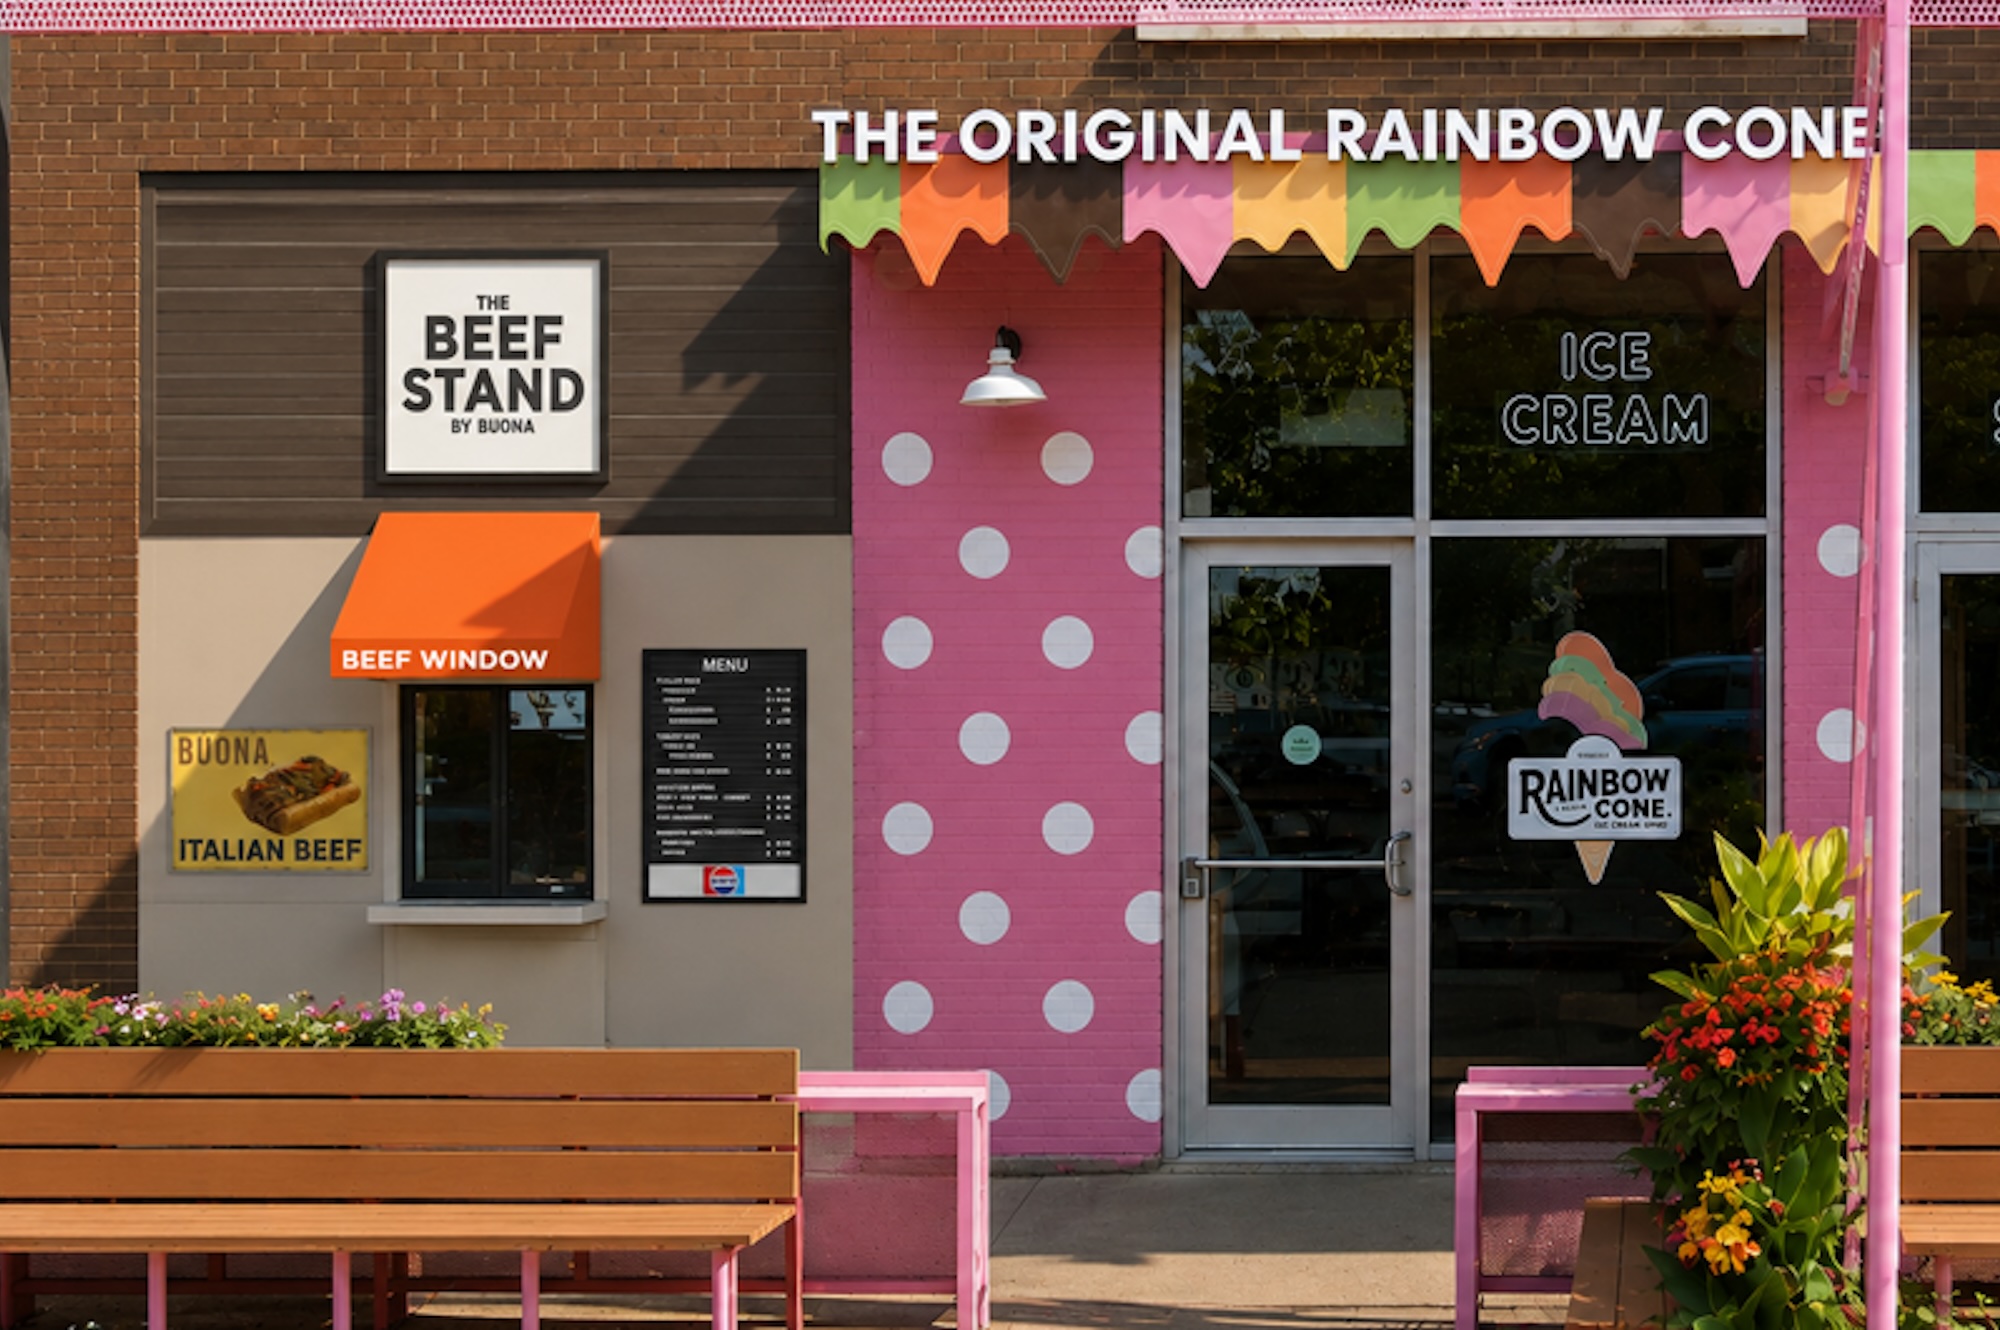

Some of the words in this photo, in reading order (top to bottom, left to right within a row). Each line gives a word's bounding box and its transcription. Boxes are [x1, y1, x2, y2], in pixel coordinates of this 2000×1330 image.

[811, 109, 939, 164] THE
[958, 107, 1301, 164] ORIGINAL
[1327, 106, 1663, 162] RAINBOW
[1684, 105, 1869, 160] CONE
[476, 295, 510, 311] THE
[425, 315, 563, 360] BEEF
[1561, 331, 1653, 381] ICE
[402, 367, 585, 413] STAND
[451, 418, 471, 434] BY
[478, 418, 535, 434] BUONA
[1501, 394, 1709, 445] CREAM
[342, 650, 411, 670] BEEF
[421, 650, 549, 670] WINDOW
[703, 657, 749, 672] MENU
[1519, 768, 1671, 827] RAINBOW
[179, 839, 284, 861] ITALIAN
[294, 839, 362, 861] BEEF
